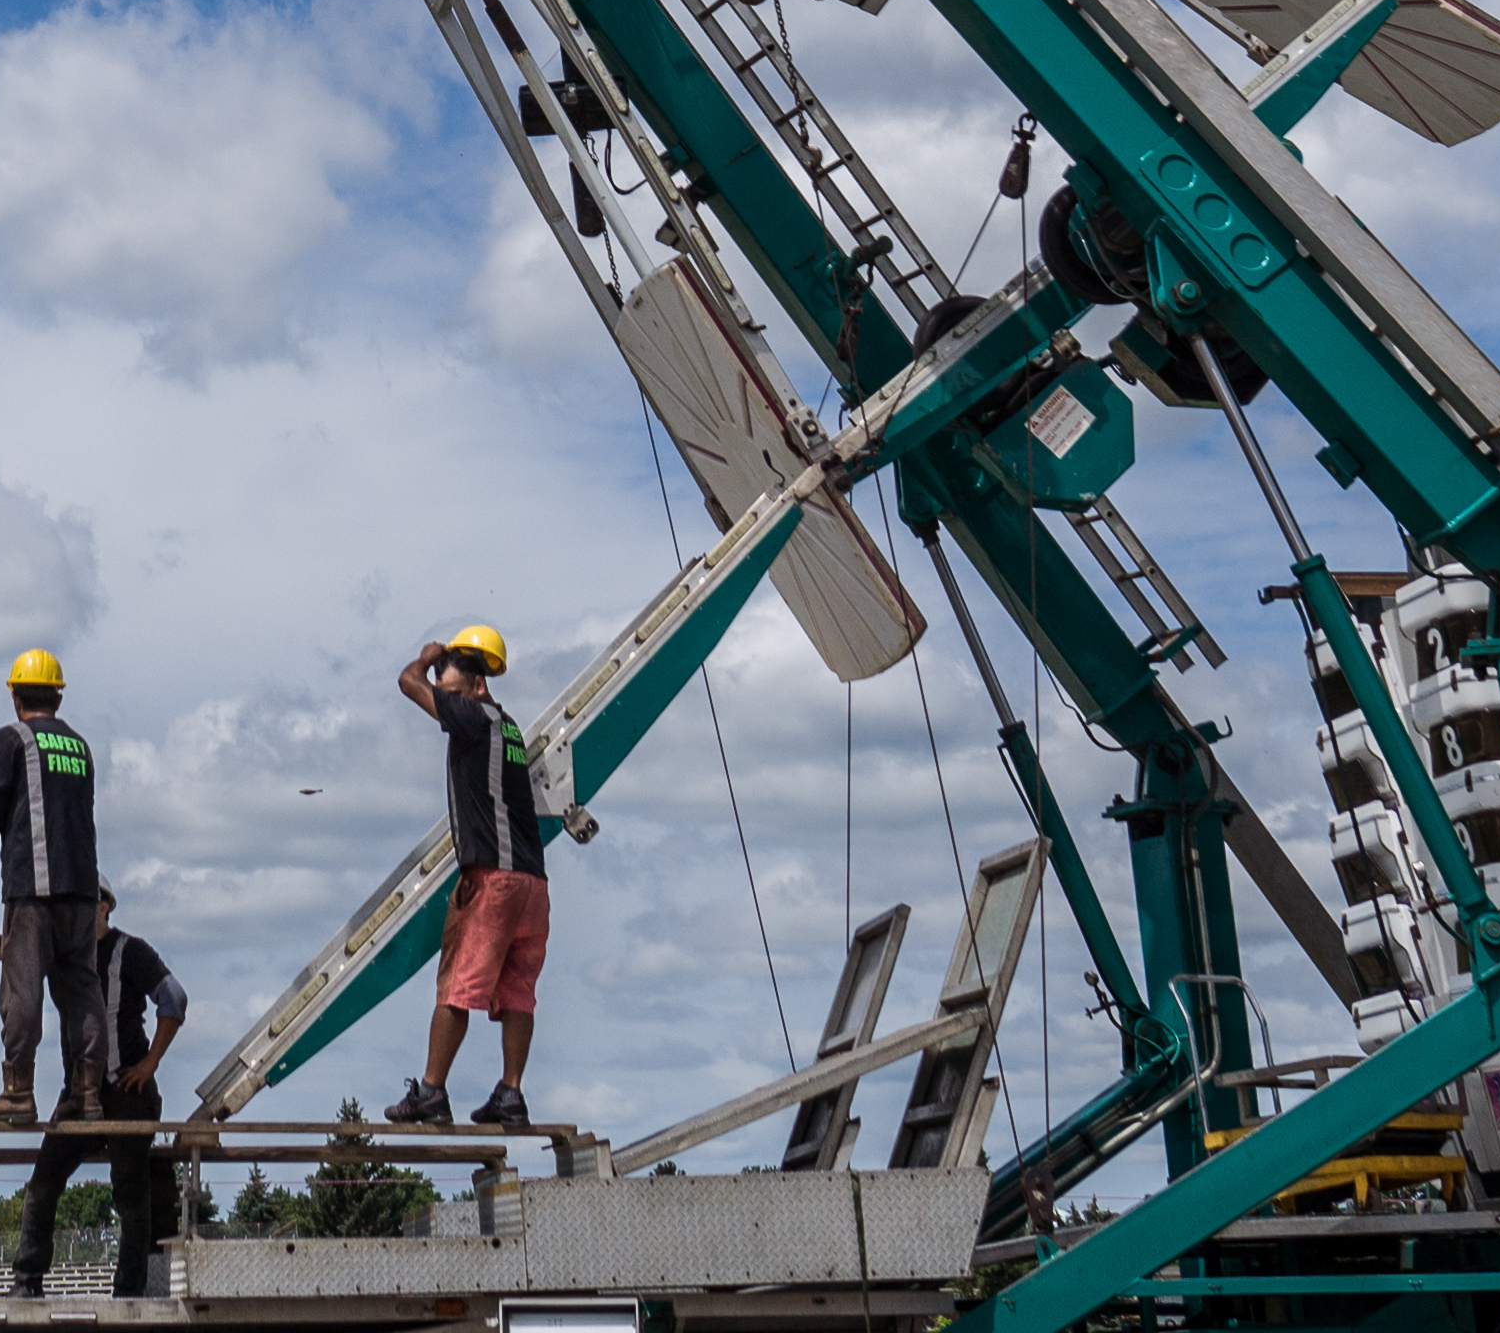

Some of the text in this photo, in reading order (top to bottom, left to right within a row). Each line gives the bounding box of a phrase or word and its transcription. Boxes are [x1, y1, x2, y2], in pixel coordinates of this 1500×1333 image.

[1427, 627, 1451, 671] 2
[36, 732, 86, 757] SAFETY
[47, 753, 87, 777] FIRST
[1441, 724, 1464, 768] 8
[1454, 821, 1475, 864] 9
